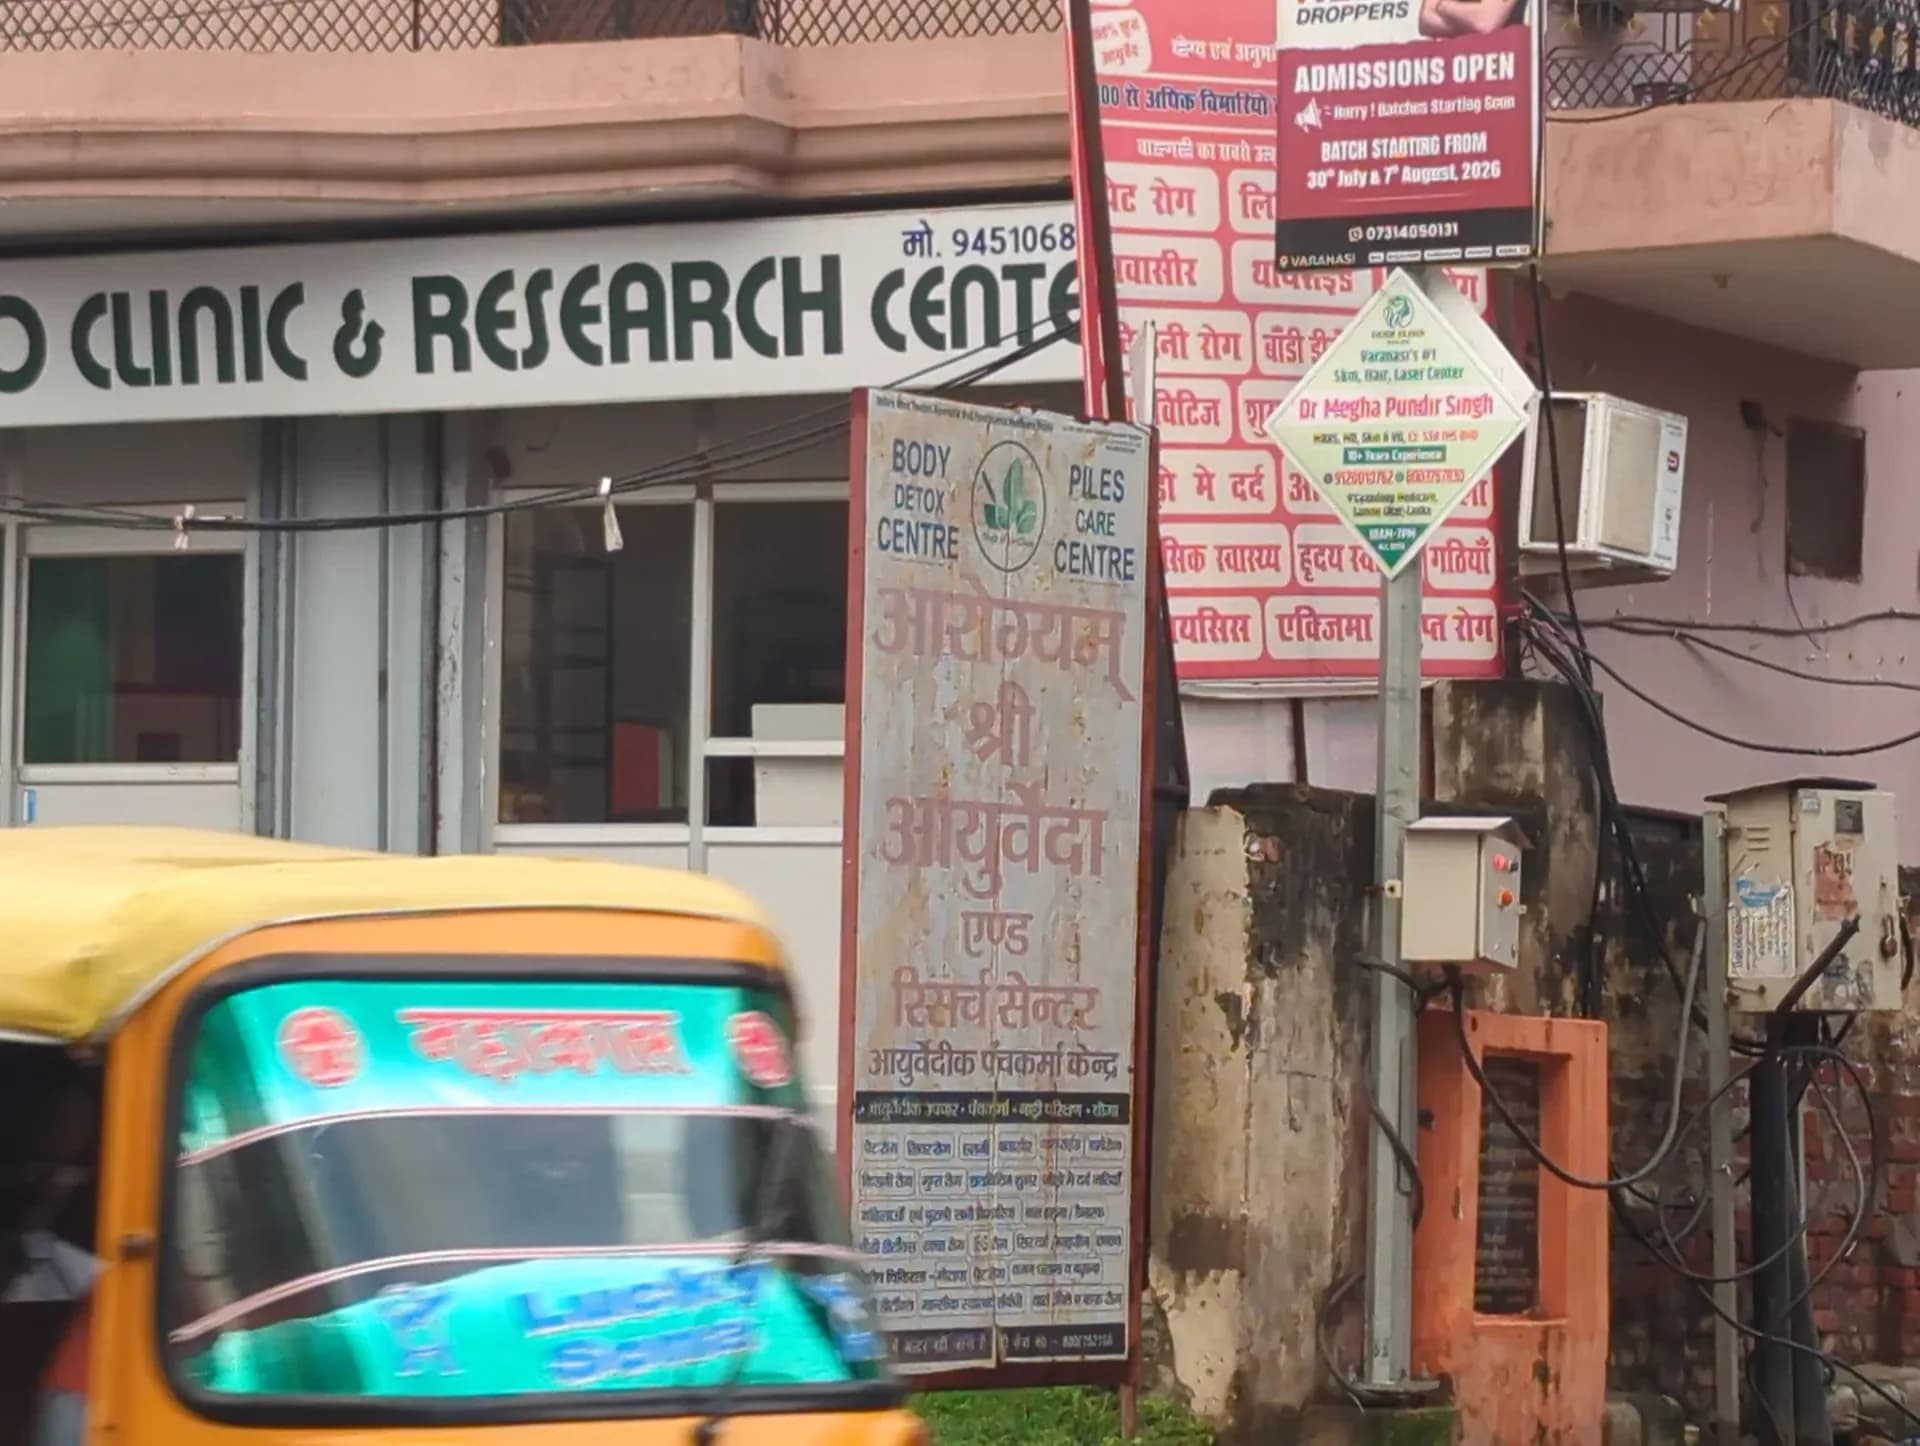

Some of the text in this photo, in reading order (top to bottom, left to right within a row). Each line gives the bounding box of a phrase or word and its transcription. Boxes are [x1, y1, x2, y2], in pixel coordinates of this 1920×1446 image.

[1296, 2, 1408, 25] DROPPERS
[1294, 52, 1515, 93] ADMISSIONS OPEN
[1334, 104, 1368, 121] Hurry
[1431, 98, 1481, 115] Starting
[1321, 132, 1487, 163] BATCH STARTING FROM
[1337, 168, 1366, 188] July
[1461, 160, 1501, 179] 2026
[1151, 178, 1195, 215] रोग
[903, 221, 1075, 258] मो. 9451068
[71, 280, 308, 390] CLINIC
[333, 288, 385, 378] &
[412, 254, 844, 374] RESEARCH
[1198, 325, 1241, 361] रोग
[1394, 366, 1424, 381] Laser
[1427, 366, 1464, 380] Center
[1300, 392, 1493, 422] Dr Megha Pundir Singh
[891, 438, 951, 478] BODY
[894, 483, 945, 514] DETOX
[1068, 464, 1125, 503] PILES
[1229, 464, 1265, 502] दर्द
[877, 516, 960, 560] CENTRE
[1075, 509, 1116, 537] CARE
[1053, 540, 1136, 581] CENTRE
[1452, 605, 1494, 644] रोग
[961, 911, 1034, 958] एण्ड
[892, 966, 1100, 1031] रिसर्च सेन्टर
